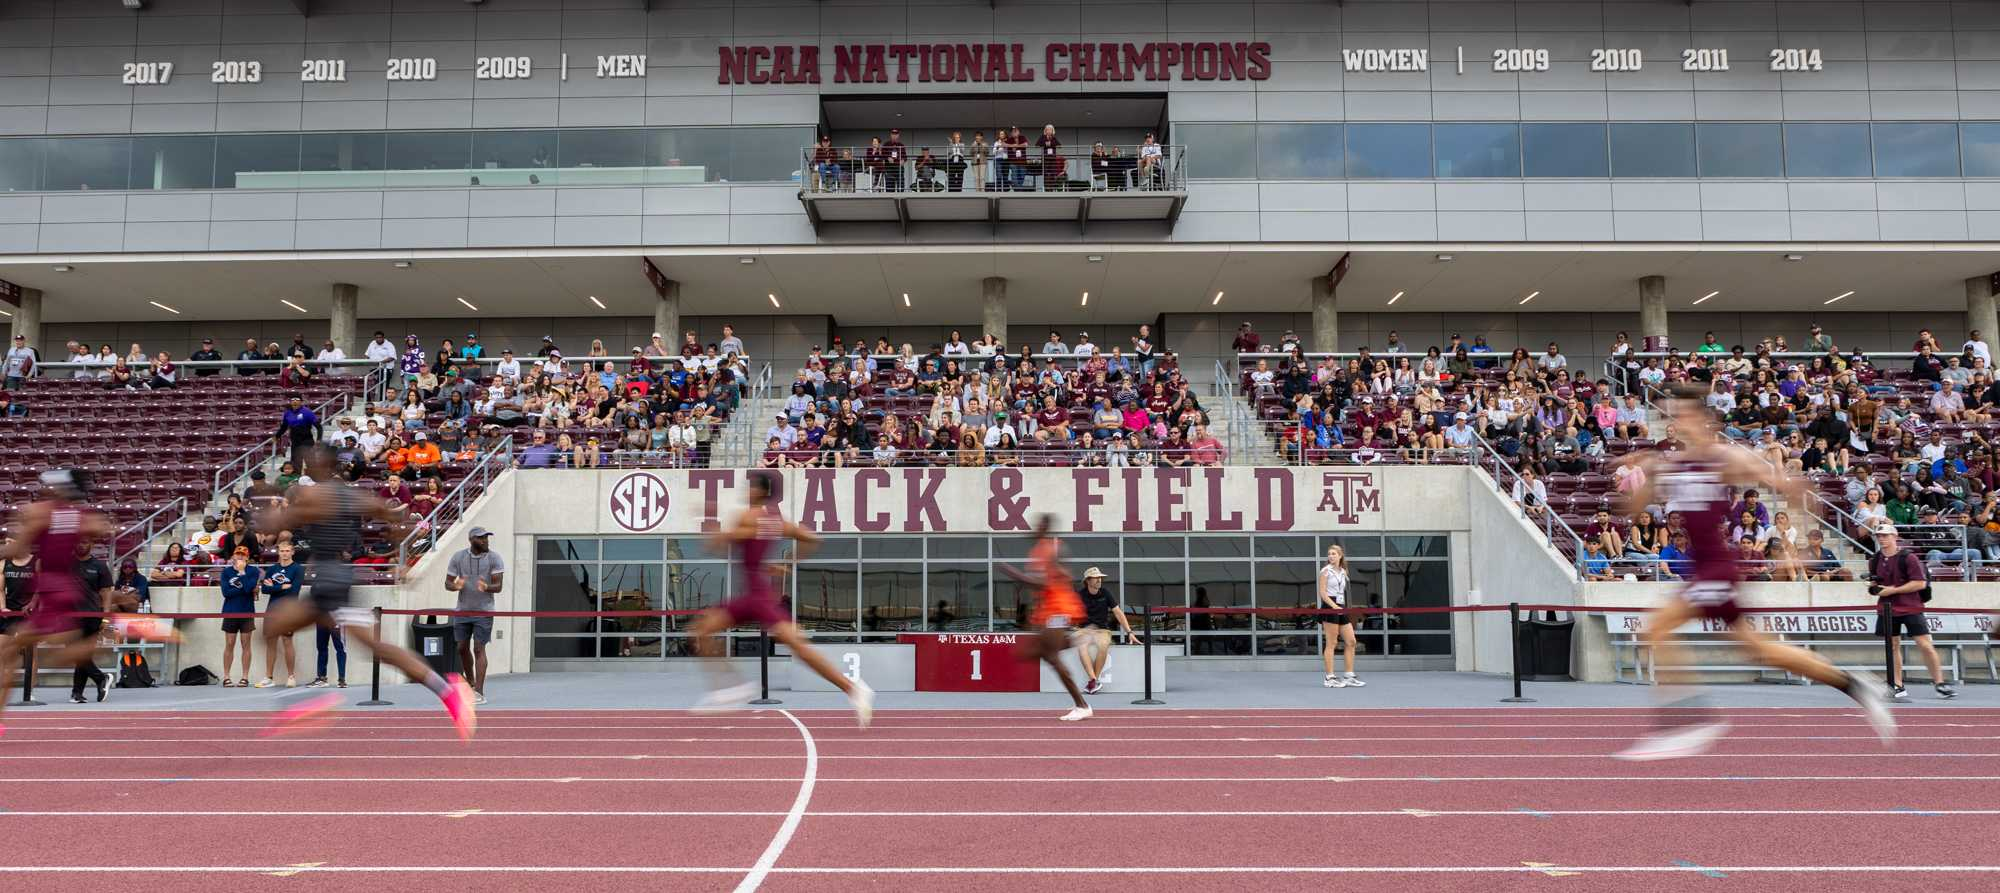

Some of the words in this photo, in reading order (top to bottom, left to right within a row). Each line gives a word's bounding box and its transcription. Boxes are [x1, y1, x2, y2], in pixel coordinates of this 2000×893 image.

[123, 62, 173, 84] 2017
[211, 61, 261, 83] 2013
[301, 59, 345, 81] 2011
[386, 58, 436, 80] 2010
[476, 56, 531, 79] 2009
[596, 54, 647, 77] MEN
[718, 45, 821, 84] NCAA
[834, 43, 1035, 82] NATIONAL
[1045, 42, 1271, 81] CHAMPIONS
[1343, 48, 1428, 71] WOMEN
[1494, 48, 1550, 71] 2009
[1592, 48, 1642, 71] 2010
[1683, 48, 1729, 71] 2011
[1771, 48, 1823, 71] 2014
[612, 474, 667, 530] SEC
[988, 468, 1032, 530] &
[1072, 467, 1295, 530] FIELD
[1763, 616, 1801, 631] A&M
[1807, 616, 1868, 631] AGGIES
[953, 634, 990, 644] TEXAS
[993, 634, 1016, 644] A&M
[843, 652, 861, 682] 3
[970, 649, 982, 680] 1
